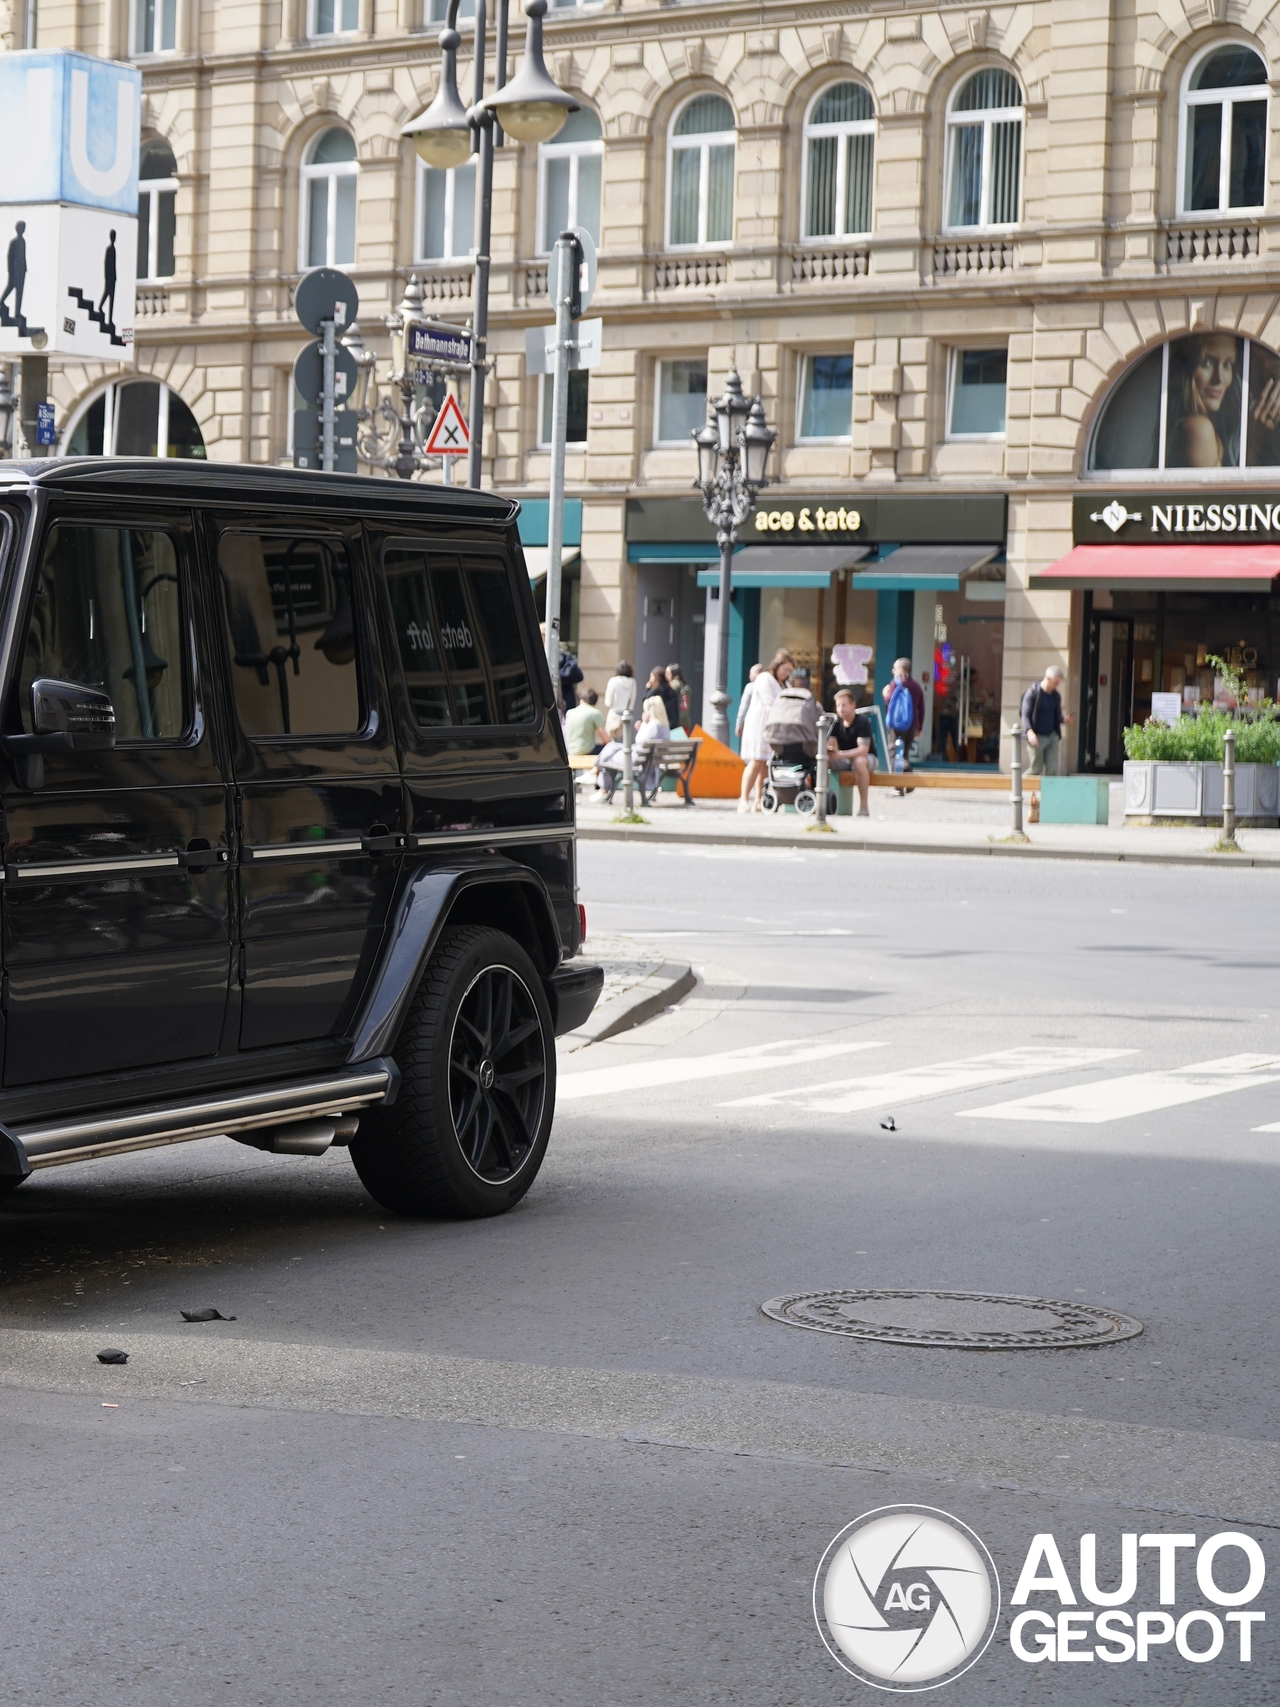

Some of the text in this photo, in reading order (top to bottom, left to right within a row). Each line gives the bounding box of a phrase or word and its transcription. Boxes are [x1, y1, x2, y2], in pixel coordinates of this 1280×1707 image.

[68, 67, 136, 197] U
[755, 506, 861, 531] ace & tate
